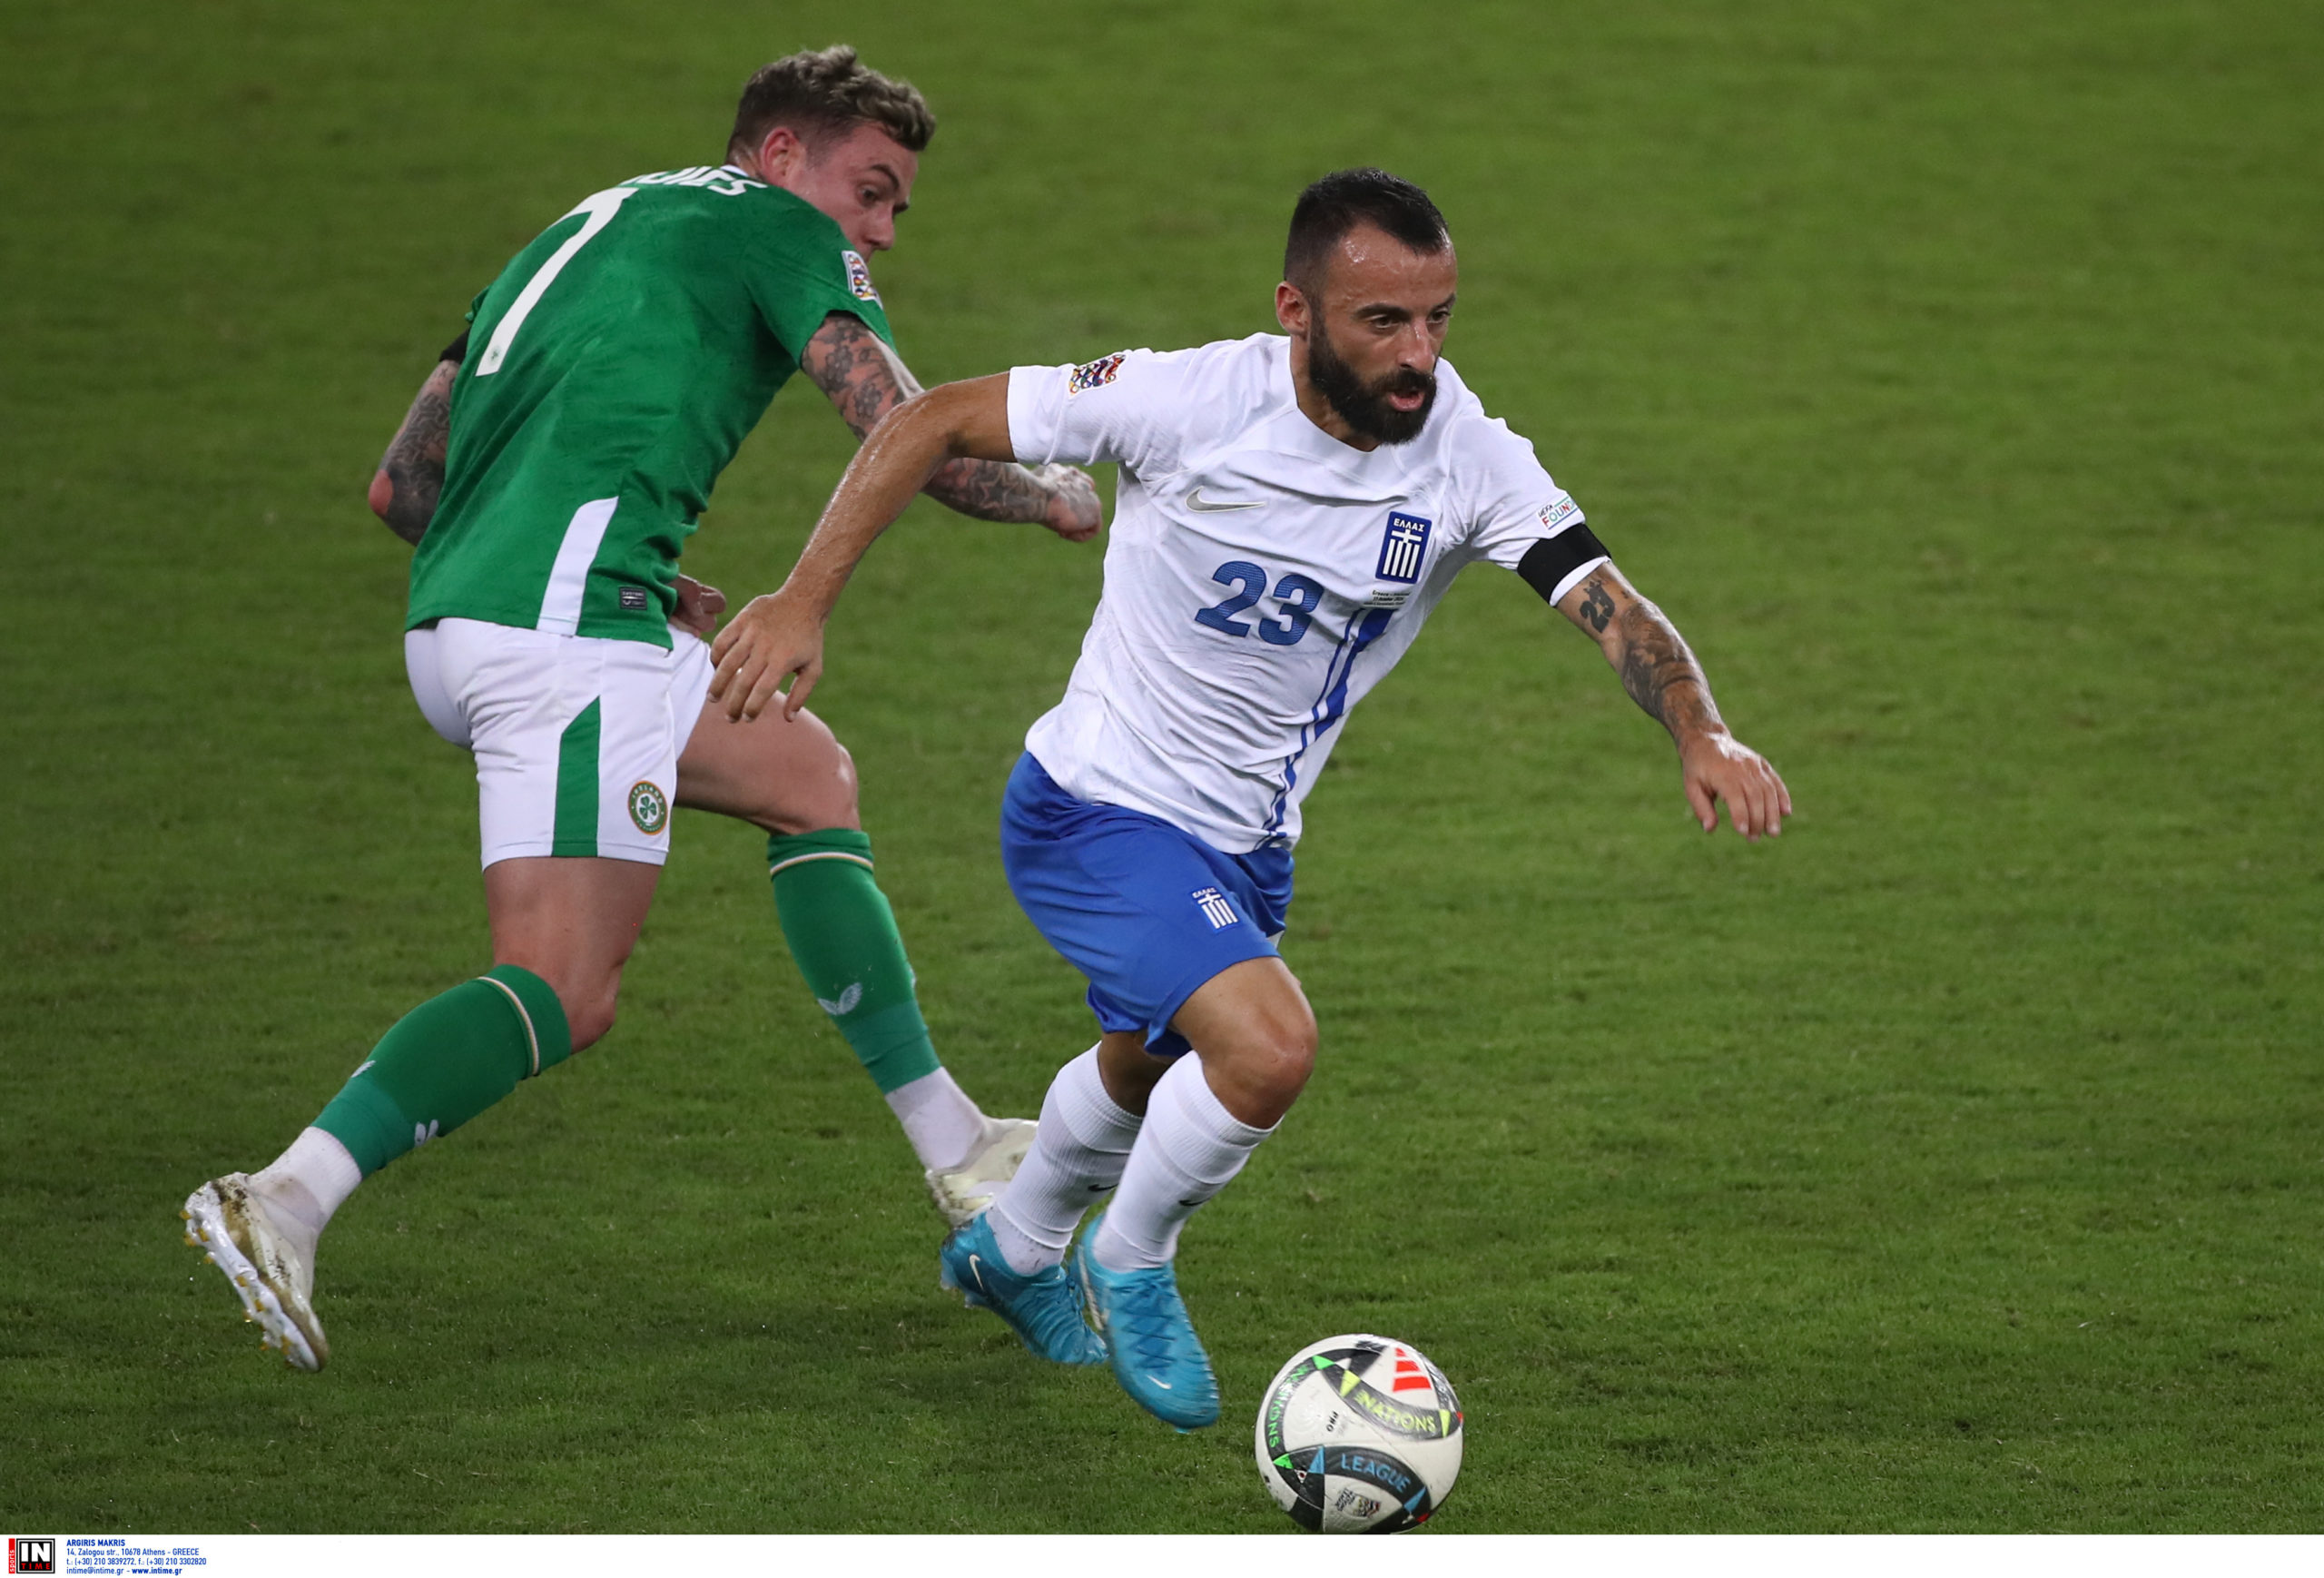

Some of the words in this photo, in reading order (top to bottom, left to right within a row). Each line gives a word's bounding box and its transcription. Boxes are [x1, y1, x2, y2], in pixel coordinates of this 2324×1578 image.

[475, 187, 639, 377] 7
[1393, 518, 1424, 532] ΕΛΛΑΣ
[1195, 560, 1324, 646] 23
[1355, 1389, 1437, 1433] NATIONS
[1341, 1453, 1412, 1493] LEAGUE
